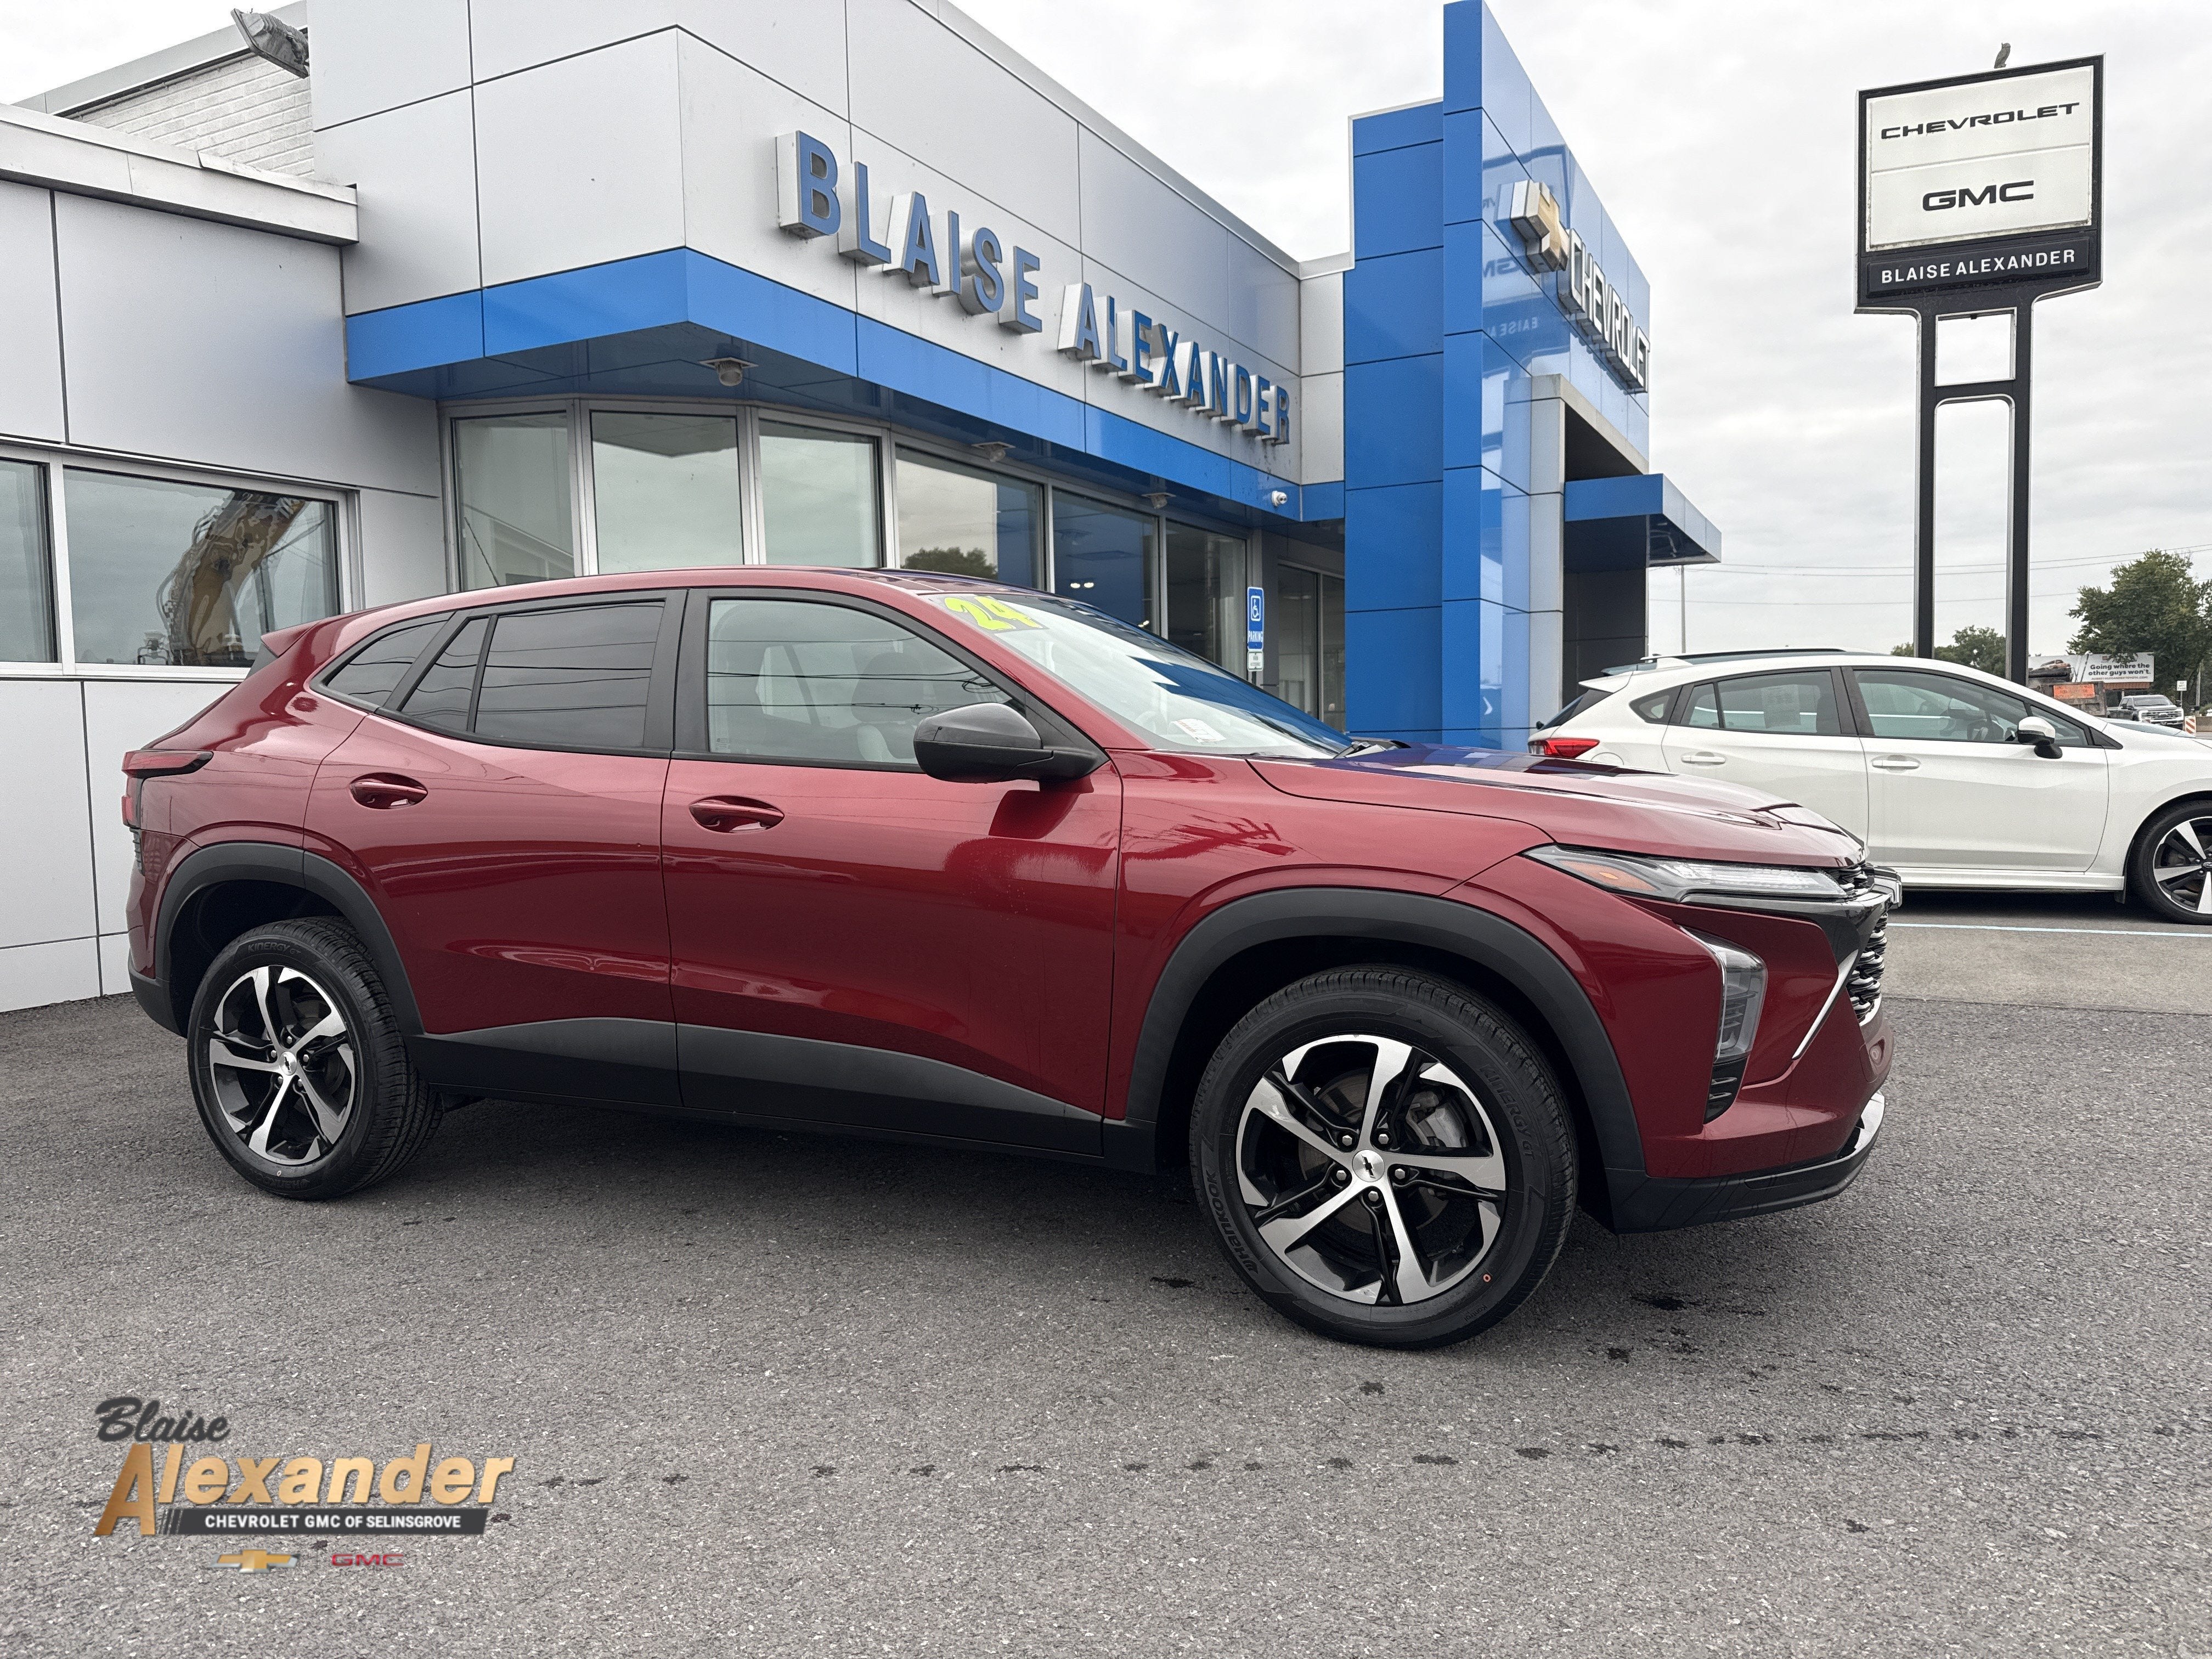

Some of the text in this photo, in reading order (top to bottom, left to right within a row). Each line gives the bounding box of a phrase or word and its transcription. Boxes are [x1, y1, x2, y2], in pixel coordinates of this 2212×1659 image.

[1881, 102, 2080, 139] CHEVROLET
[1922, 180, 2034, 211] GMC
[1881, 249, 2075, 284] BLAISE ALEXANDER
[794, 130, 1290, 445] BLAISE ALEXANDER
[1567, 228, 1651, 393] CHEVROLET
[944, 595, 1043, 631] 24
